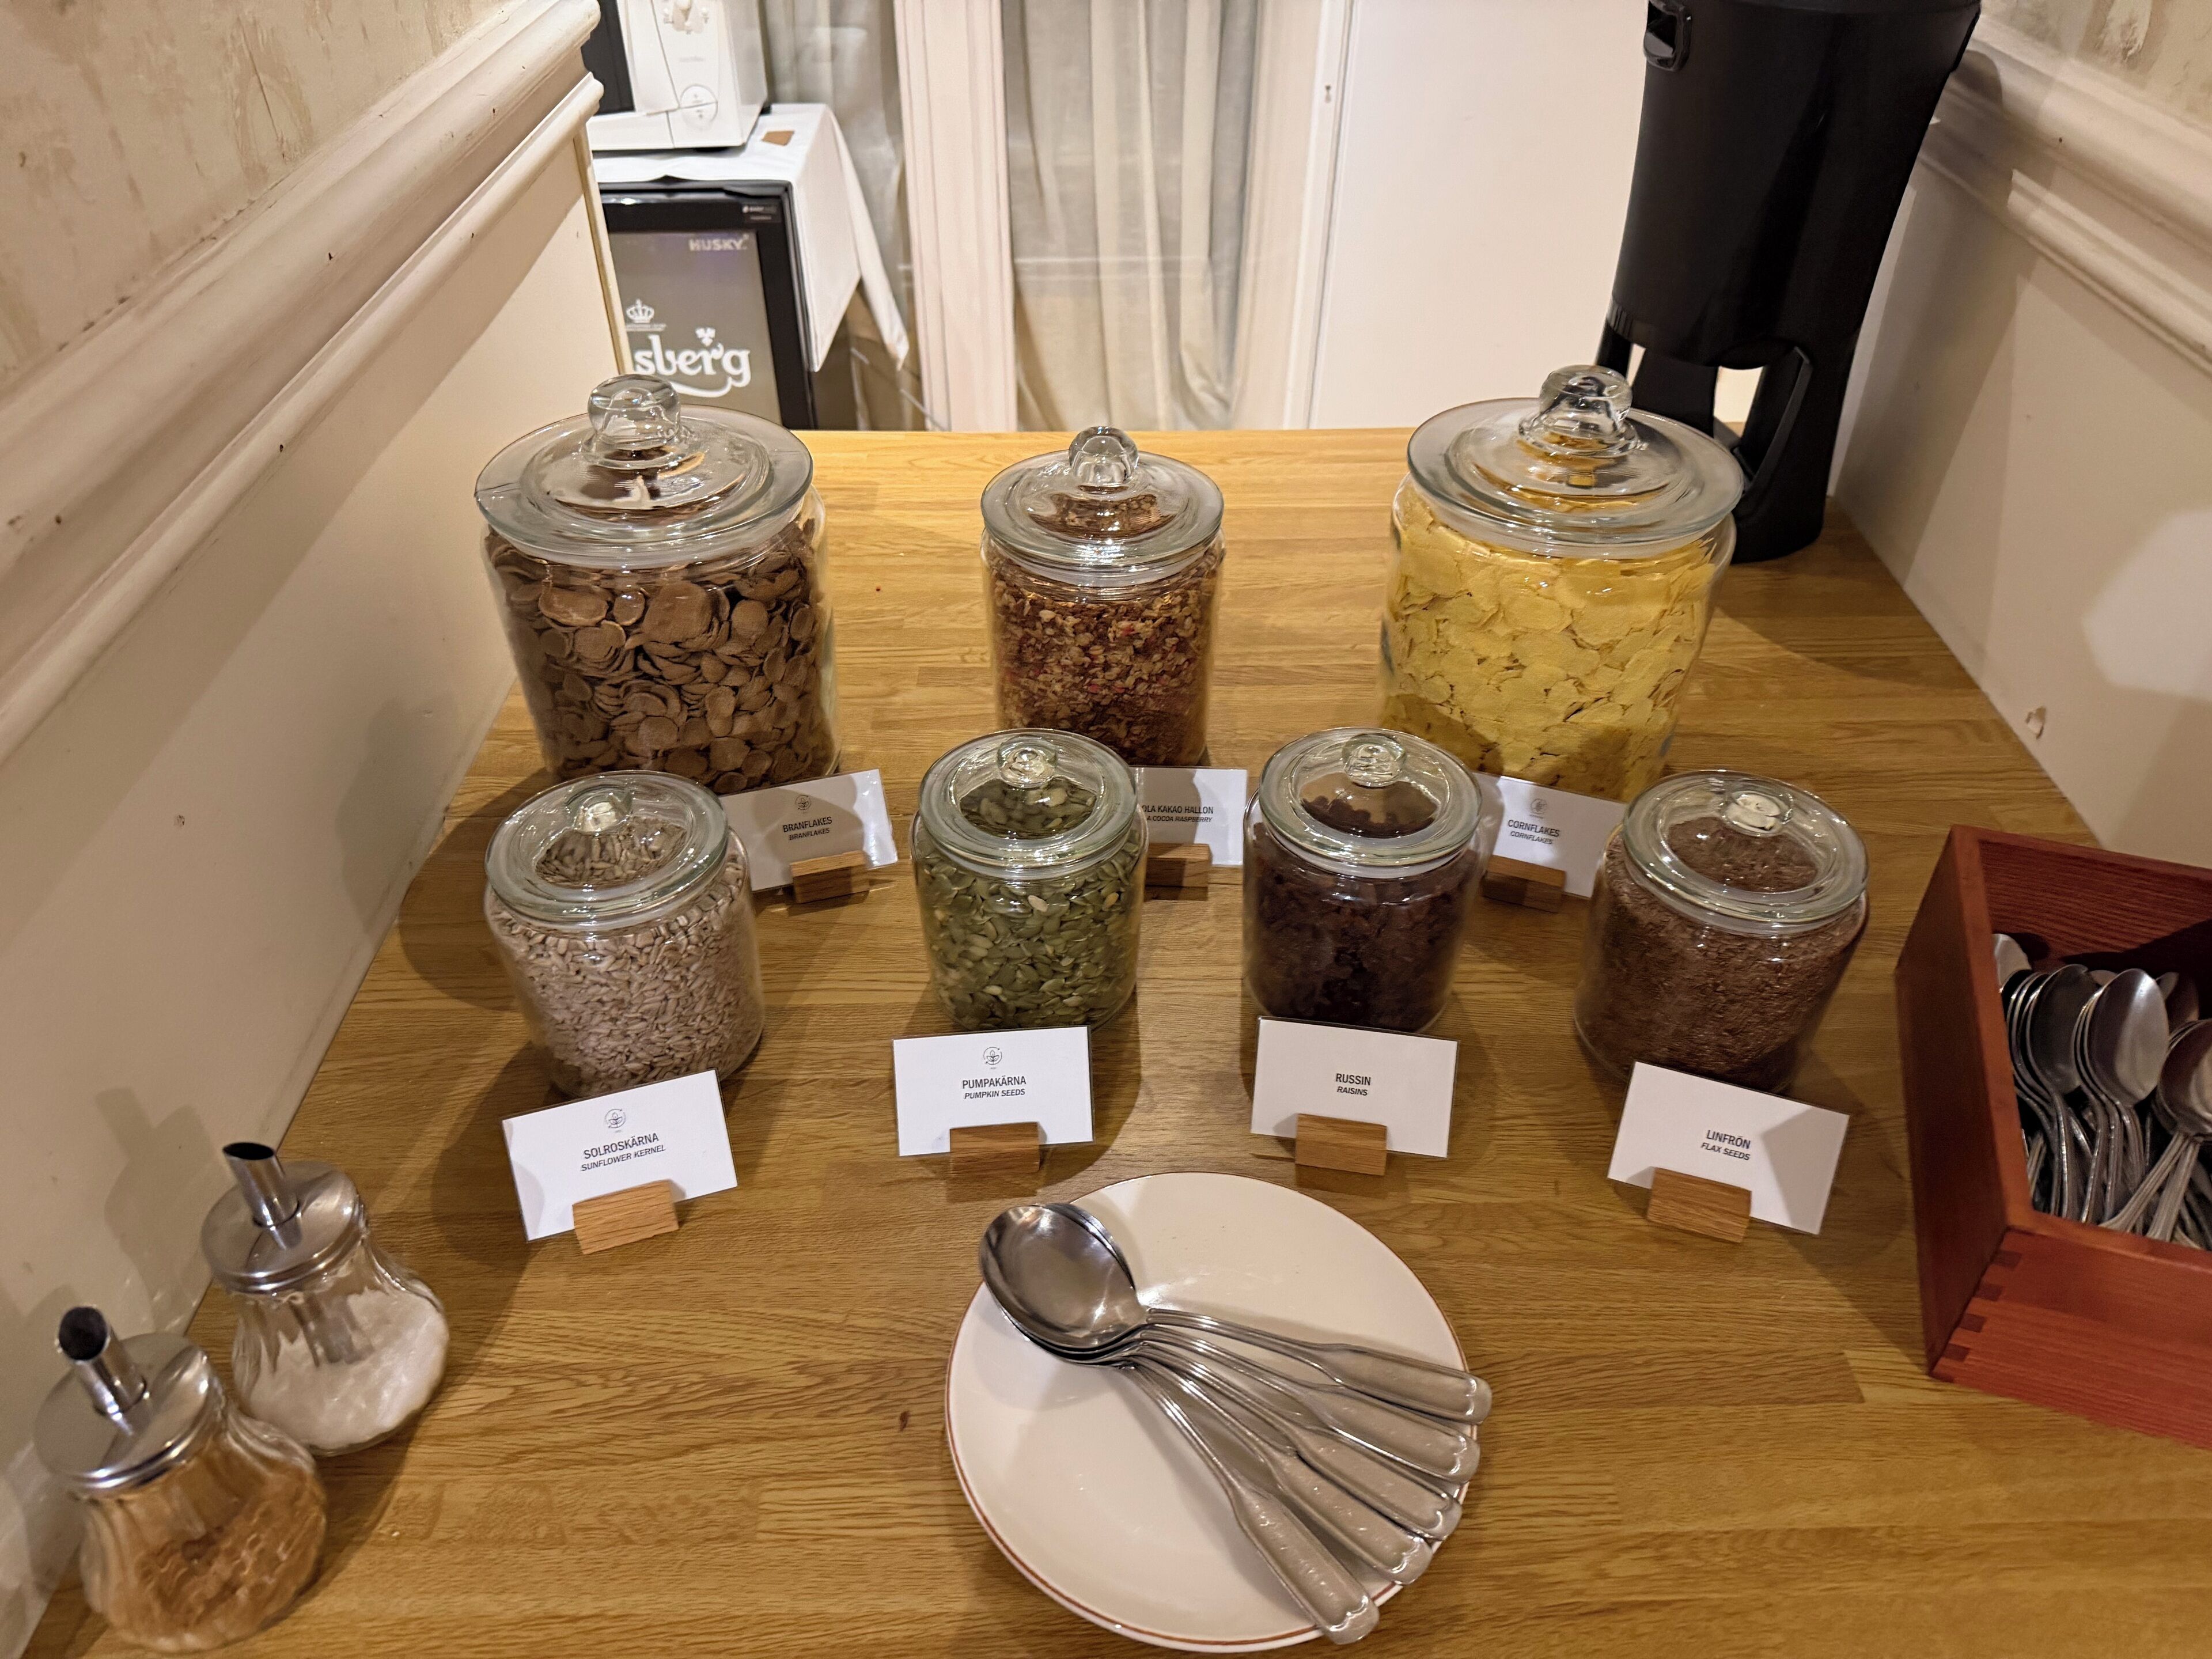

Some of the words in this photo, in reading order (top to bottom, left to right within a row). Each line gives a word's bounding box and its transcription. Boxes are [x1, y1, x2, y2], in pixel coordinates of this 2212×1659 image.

[690, 238, 743, 251] HUSKY
[634, 334, 751, 392] sberg
[1142, 805, 1156, 813] OLA
[1158, 805, 1183, 813] KAKAO
[1184, 806, 1214, 815] HALLON
[783, 816, 833, 833] BRANFLAKES
[1508, 819, 1560, 838] CORNFLAKES
[789, 828, 830, 841] BRANFLAKES
[1510, 831, 1554, 845] CORNFLAKES
[962, 1075, 1027, 1089] PUMPAKÄRNA
[1335, 1073, 1371, 1086] RUSSIN
[964, 1090, 999, 1100] PUMPKIN
[1001, 1088, 1025, 1097] SEEDS
[1337, 1086, 1368, 1096] RAISINS
[584, 1132, 659, 1160] SOLROSKÄRNA
[1706, 1130, 1751, 1150] LINFRÖN
[581, 1153, 632, 1172] SUNFLOWER
[634, 1145, 666, 1158] KERNEL
[1700, 1142, 1722, 1153] FLAX
[1723, 1148, 1751, 1161] SEEDS
